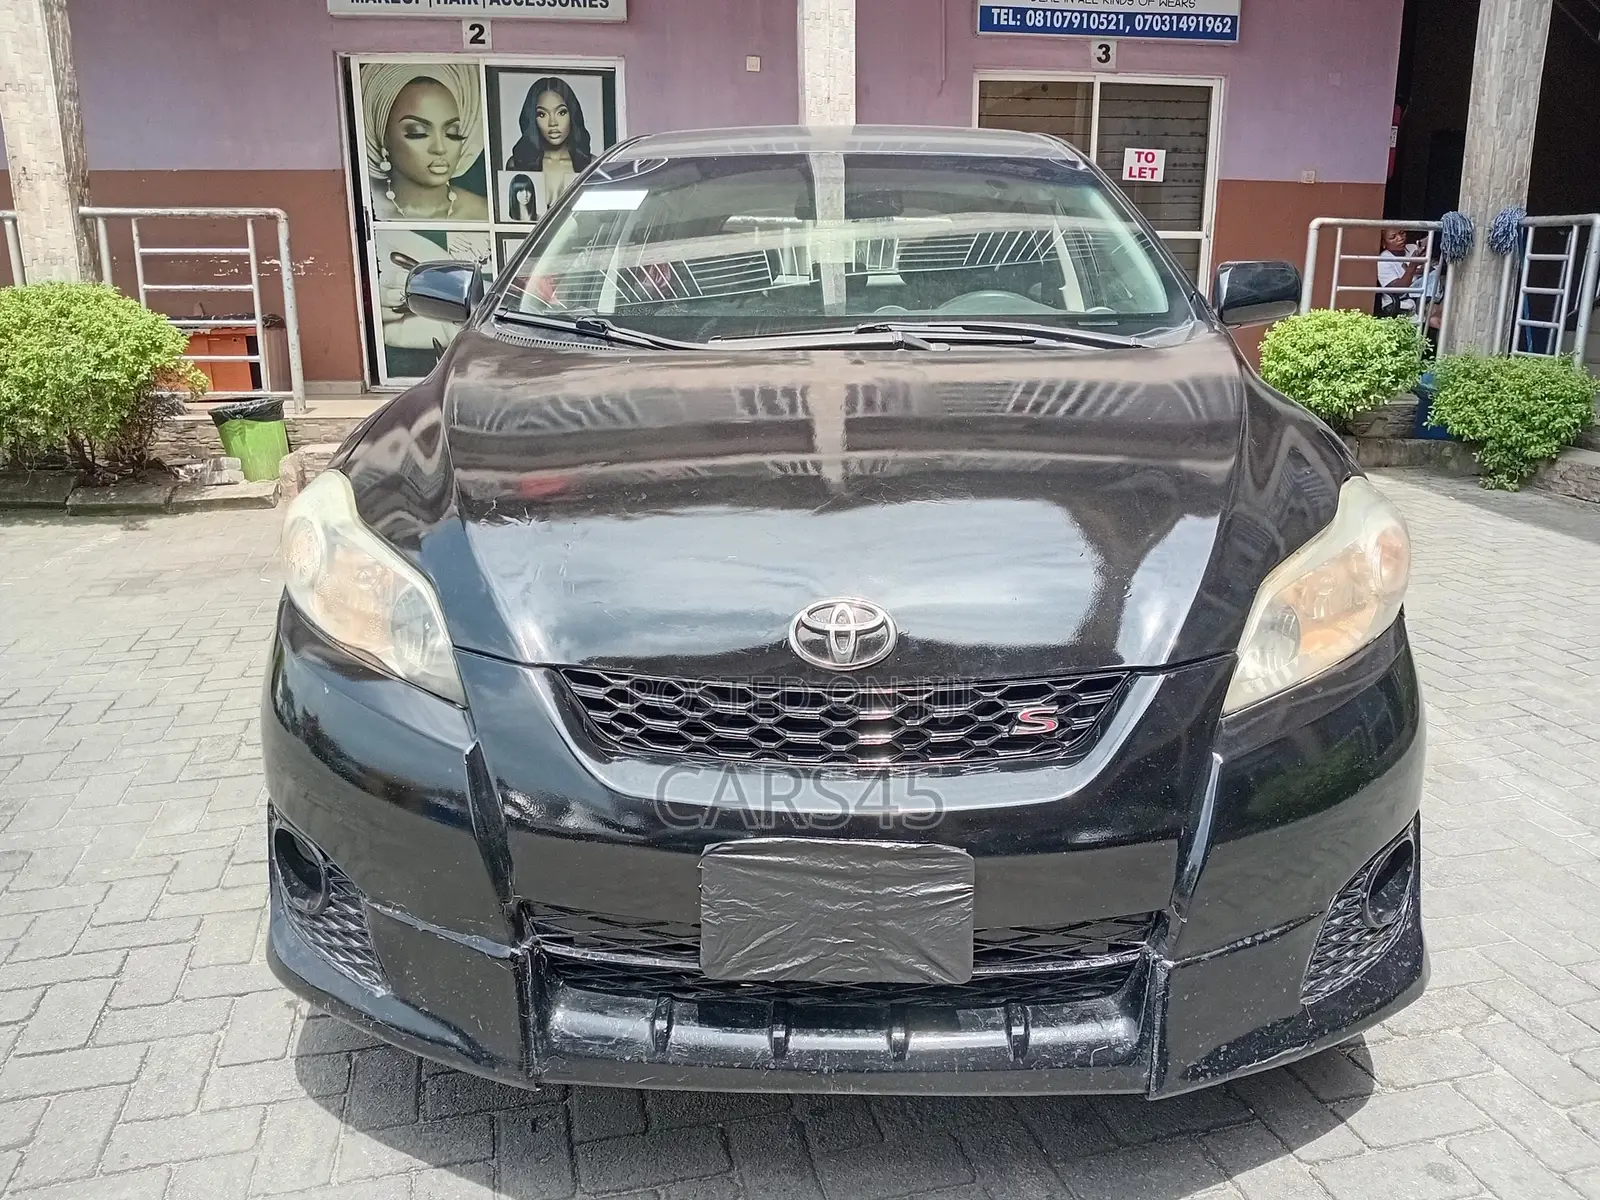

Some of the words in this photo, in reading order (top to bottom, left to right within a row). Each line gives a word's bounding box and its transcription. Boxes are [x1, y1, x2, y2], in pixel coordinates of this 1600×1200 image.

[991, 8, 1021, 26] TEL:
[1025, 9, 1131, 33] 08107910521,
[1134, 14, 1232, 33] 07031491962
[469, 23, 486, 44] 2
[1096, 43, 1111, 63] 3
[1135, 151, 1155, 163] TO
[1128, 166, 1158, 179] LET
[1010, 704, 1059, 736] S
